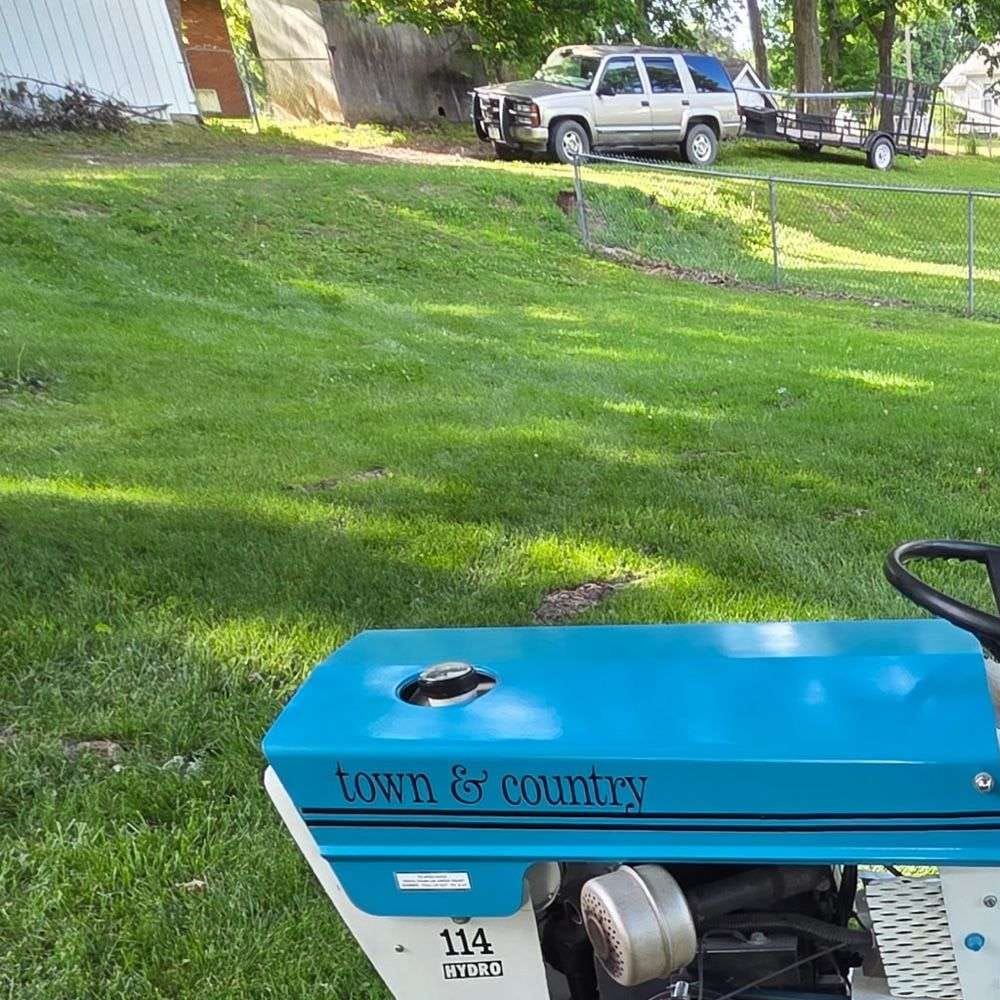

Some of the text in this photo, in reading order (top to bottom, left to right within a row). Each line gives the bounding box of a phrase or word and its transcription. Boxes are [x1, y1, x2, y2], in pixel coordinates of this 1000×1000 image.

[335, 761, 648, 814] town & country
[439, 927, 494, 956] 114
[445, 961, 502, 979] HYDRO
